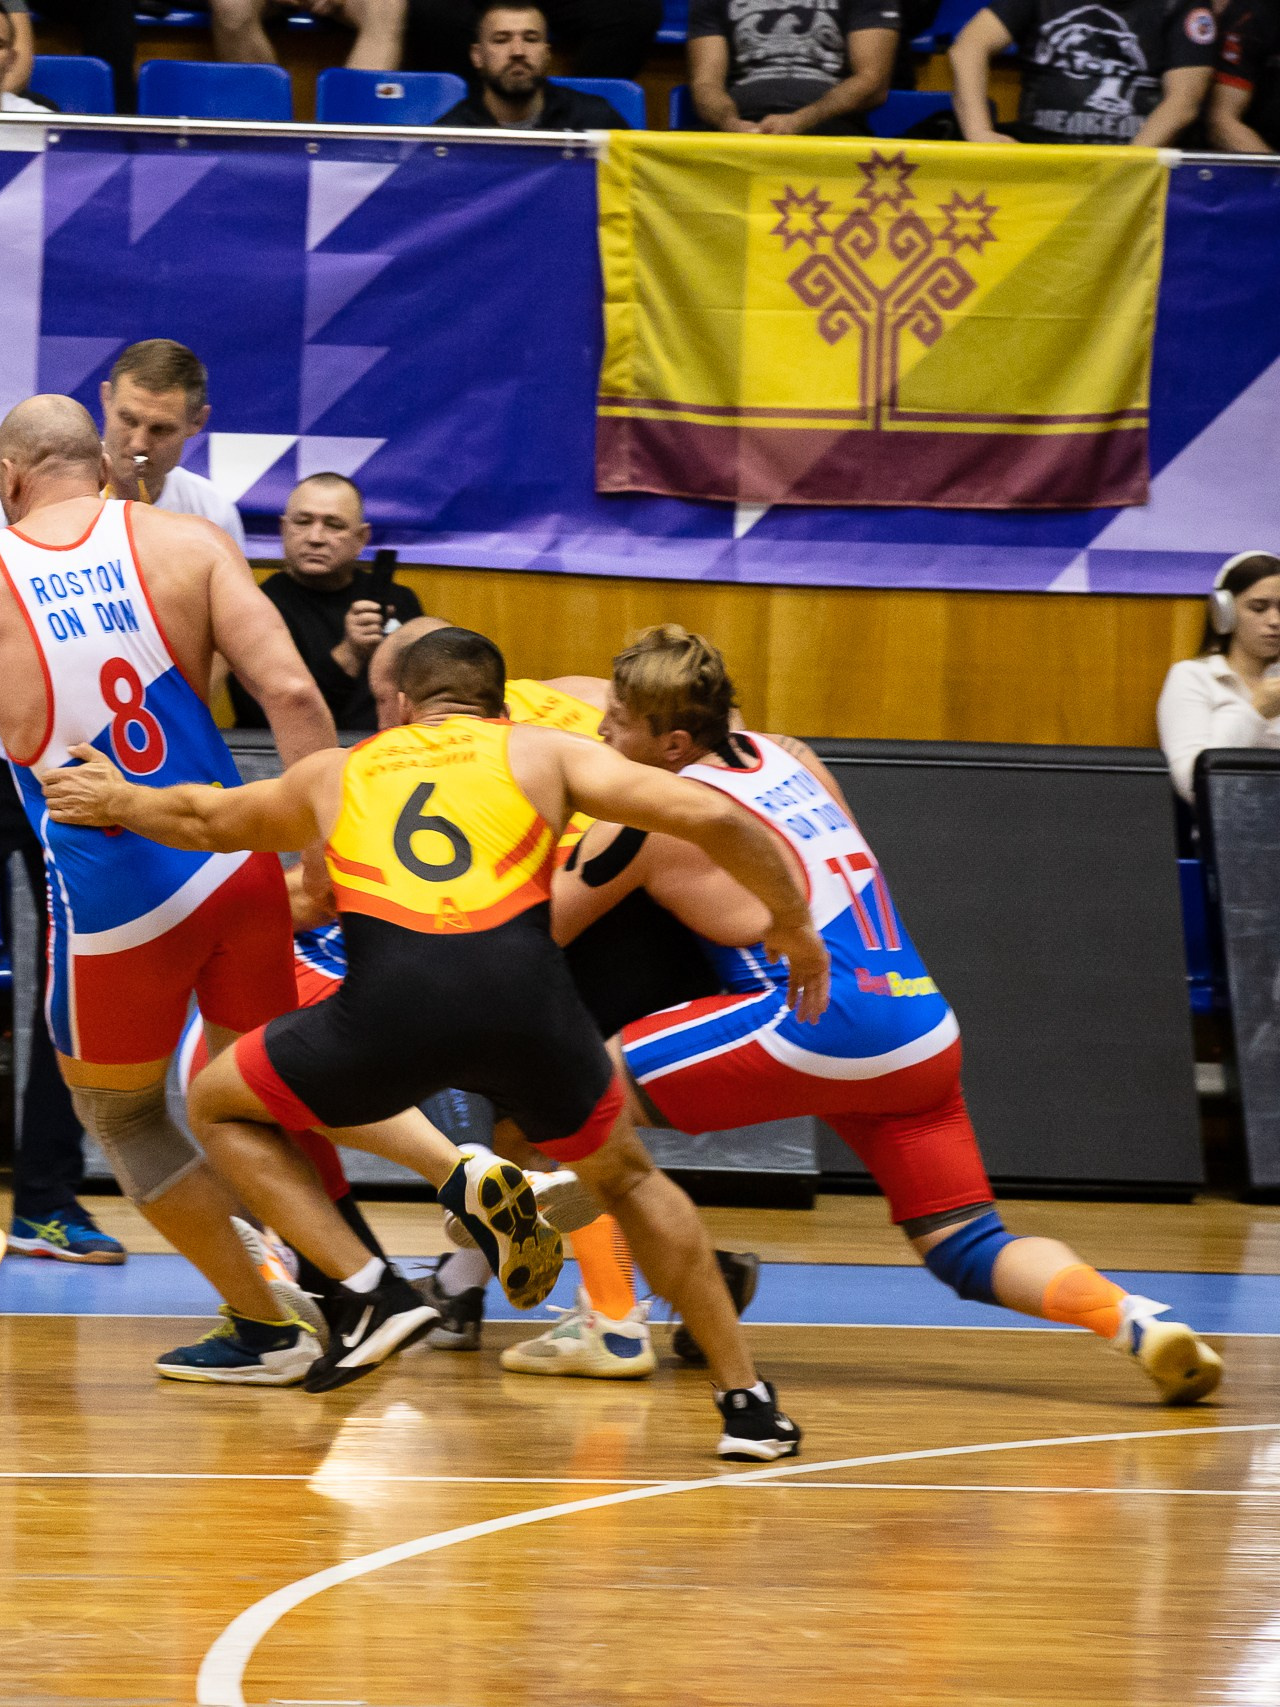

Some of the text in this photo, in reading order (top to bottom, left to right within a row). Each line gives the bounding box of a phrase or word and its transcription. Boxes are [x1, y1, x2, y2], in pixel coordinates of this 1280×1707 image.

[29, 559, 126, 606] ROSTOV
[47, 599, 140, 641] ON DON
[99, 656, 168, 777] 8
[393, 781, 473, 883] 6
[824, 851, 903, 952] 17
